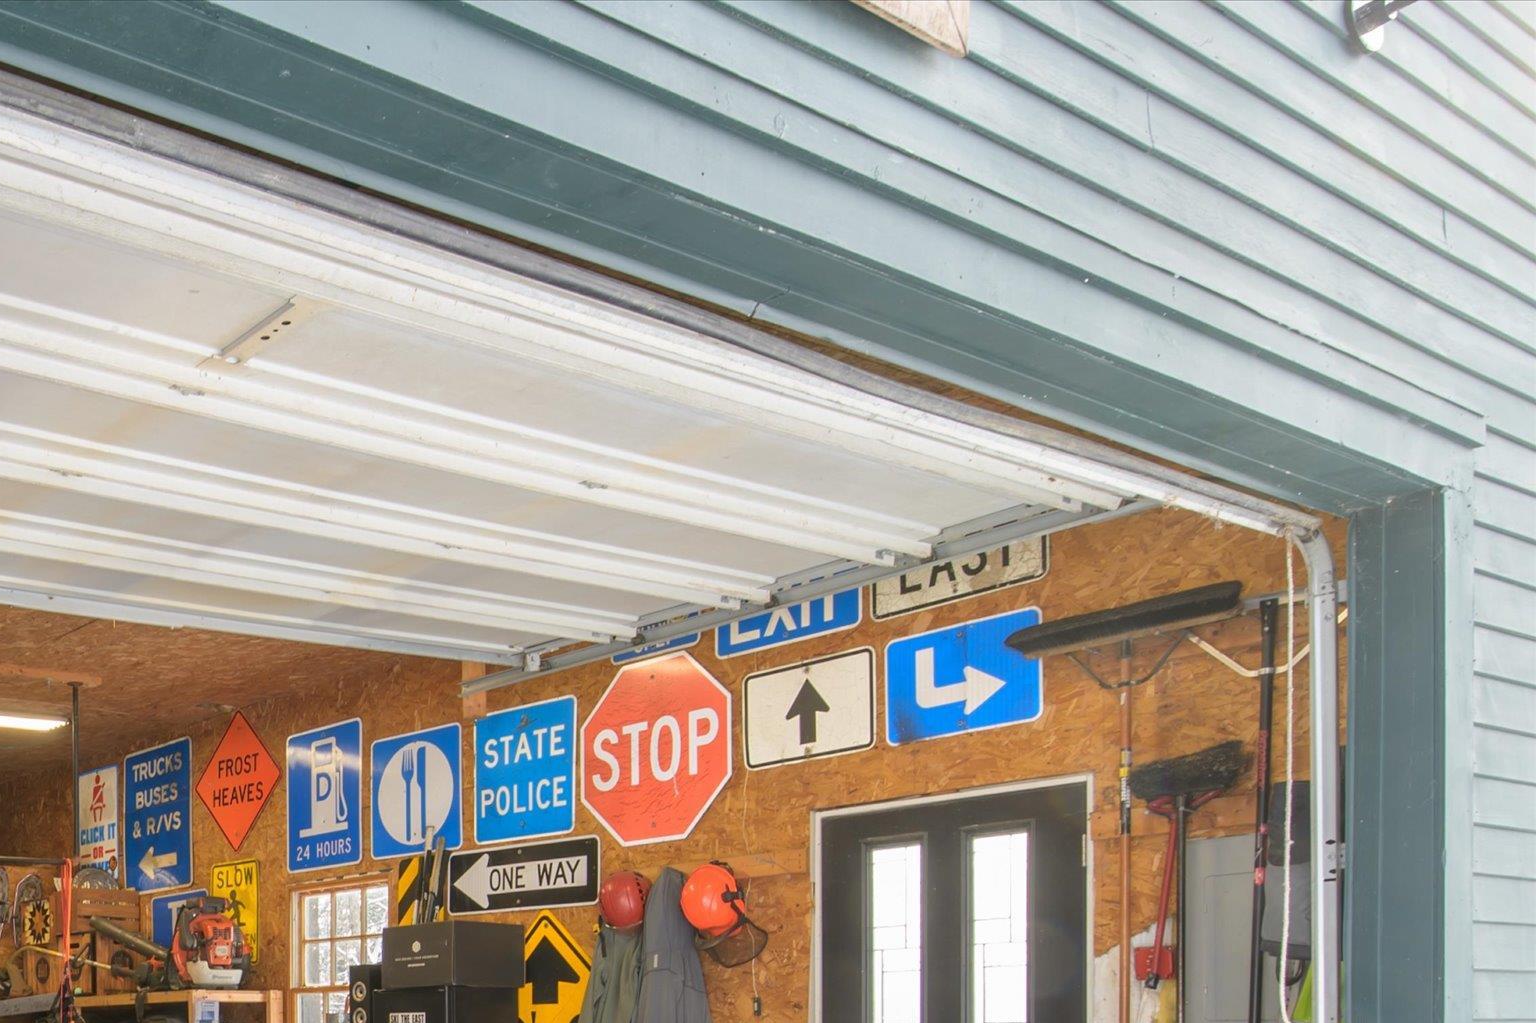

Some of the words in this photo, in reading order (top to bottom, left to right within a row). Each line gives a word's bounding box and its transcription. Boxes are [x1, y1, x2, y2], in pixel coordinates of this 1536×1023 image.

[484, 724, 566, 769] STATE
[592, 707, 720, 792] STOP
[132, 752, 183, 783] TRUCKS
[217, 753, 259, 779] FROST
[135, 782, 178, 810] BUSES
[212, 781, 264, 809] HEAVES
[316, 771, 332, 801] D
[481, 775, 567, 818] POLICE
[80, 827, 105, 846] CLICK
[107, 823, 116, 840] IT
[133, 821, 142, 839] &
[147, 811, 182, 836] R/VS
[92, 846, 104, 859] OR
[296, 844, 310, 861] 24
[316, 837, 352, 859] HOURS
[217, 866, 253, 889] SLOW
[489, 866, 525, 892] ONE
[537, 859, 582, 887] WAY
[400, 1013, 410, 1023] THE
[411, 1013, 425, 1023] EAST
